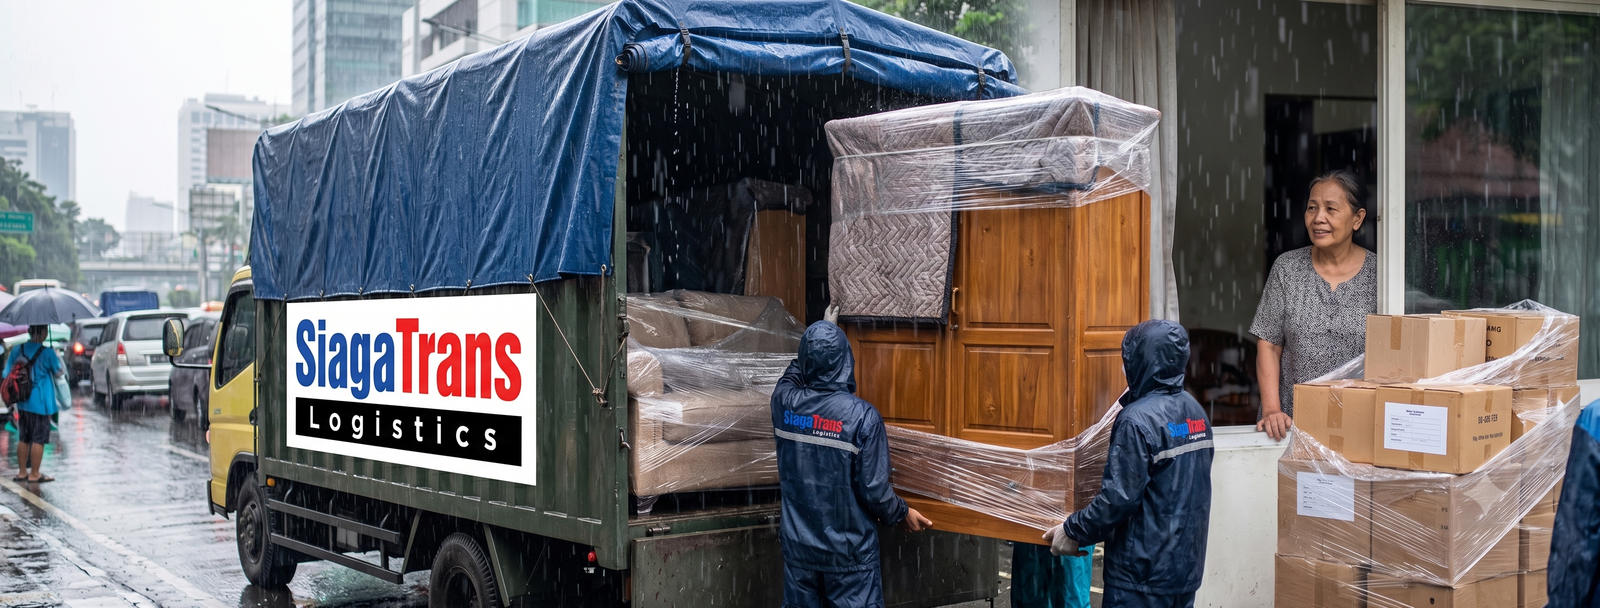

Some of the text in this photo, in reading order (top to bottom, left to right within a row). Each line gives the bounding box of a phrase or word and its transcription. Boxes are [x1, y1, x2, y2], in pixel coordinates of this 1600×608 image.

[295, 318, 522, 402] SiagaTrans
[309, 405, 497, 451] Logistics
[783, 410, 843, 433] SiagaTrans
[1167, 418, 1206, 439] SiagaTrans
[812, 429, 840, 439] Logistics
